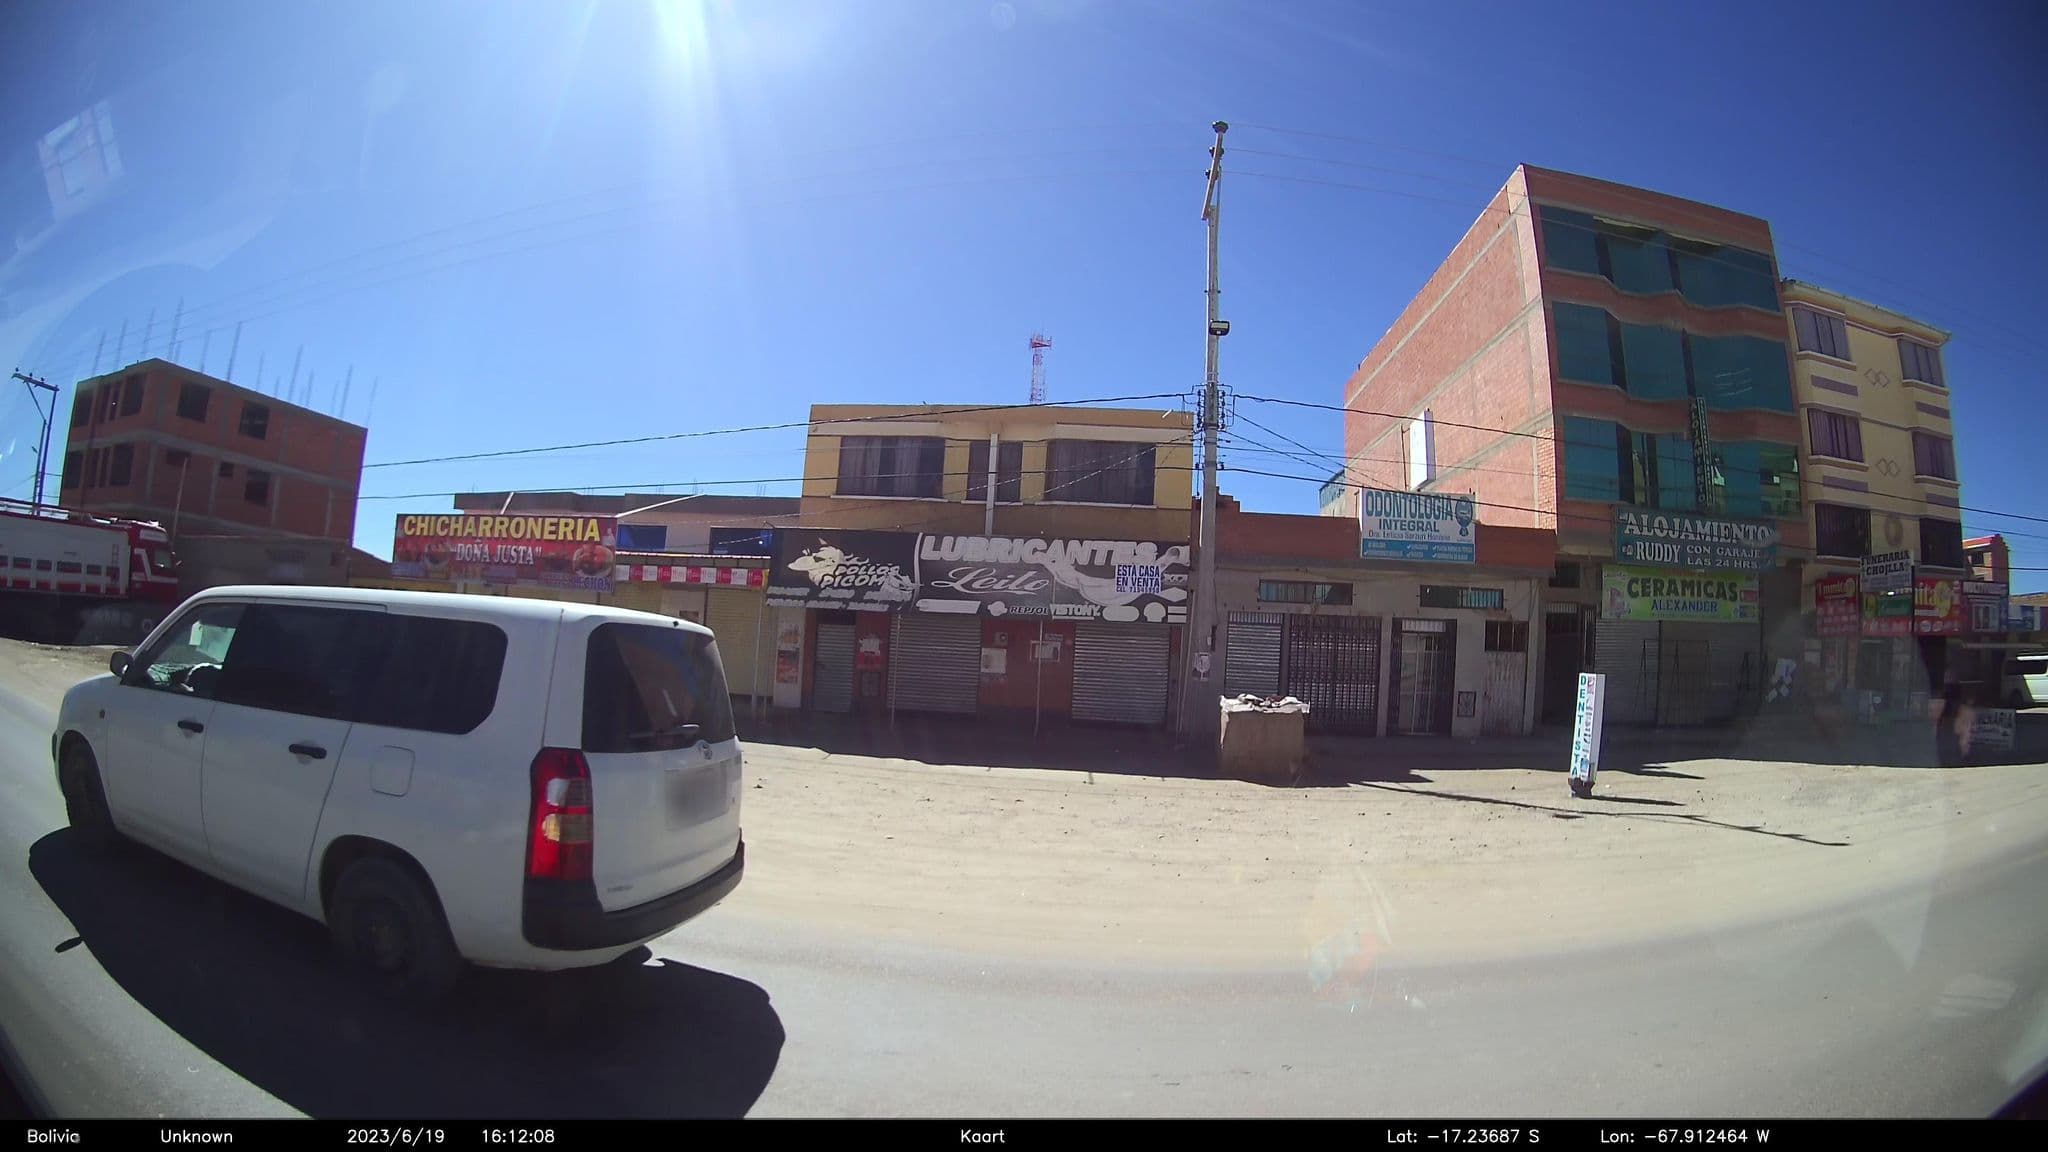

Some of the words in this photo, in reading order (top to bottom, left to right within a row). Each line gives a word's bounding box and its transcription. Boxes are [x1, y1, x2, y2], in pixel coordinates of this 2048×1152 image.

[1366, 490, 1454, 520] ODONTOLOGIA
[403, 515, 601, 542] CHICHARRONERIA
[1379, 518, 1440, 533] INTEGRAL
[919, 535, 1159, 566] LUBRICANTES
[1686, 544, 1711, 555] CON
[1716, 546, 1761, 559] GARAJE
[1687, 557, 1712, 567] LAS
[1716, 559, 1730, 568] 24
[1861, 550, 1910, 567] FUNERARIA
[835, 564, 900, 577] POLLOS
[1139, 565, 1160, 578] CASA
[1116, 576, 1128, 587] EN
[1131, 576, 1160, 588] VENTA
[1627, 576, 1738, 603] CERAMICAS
[1009, 605, 1049, 616] REPSOL
[1651, 598, 1718, 613] ALEXANDER
[1571, 674, 1587, 777] DENTISTA
